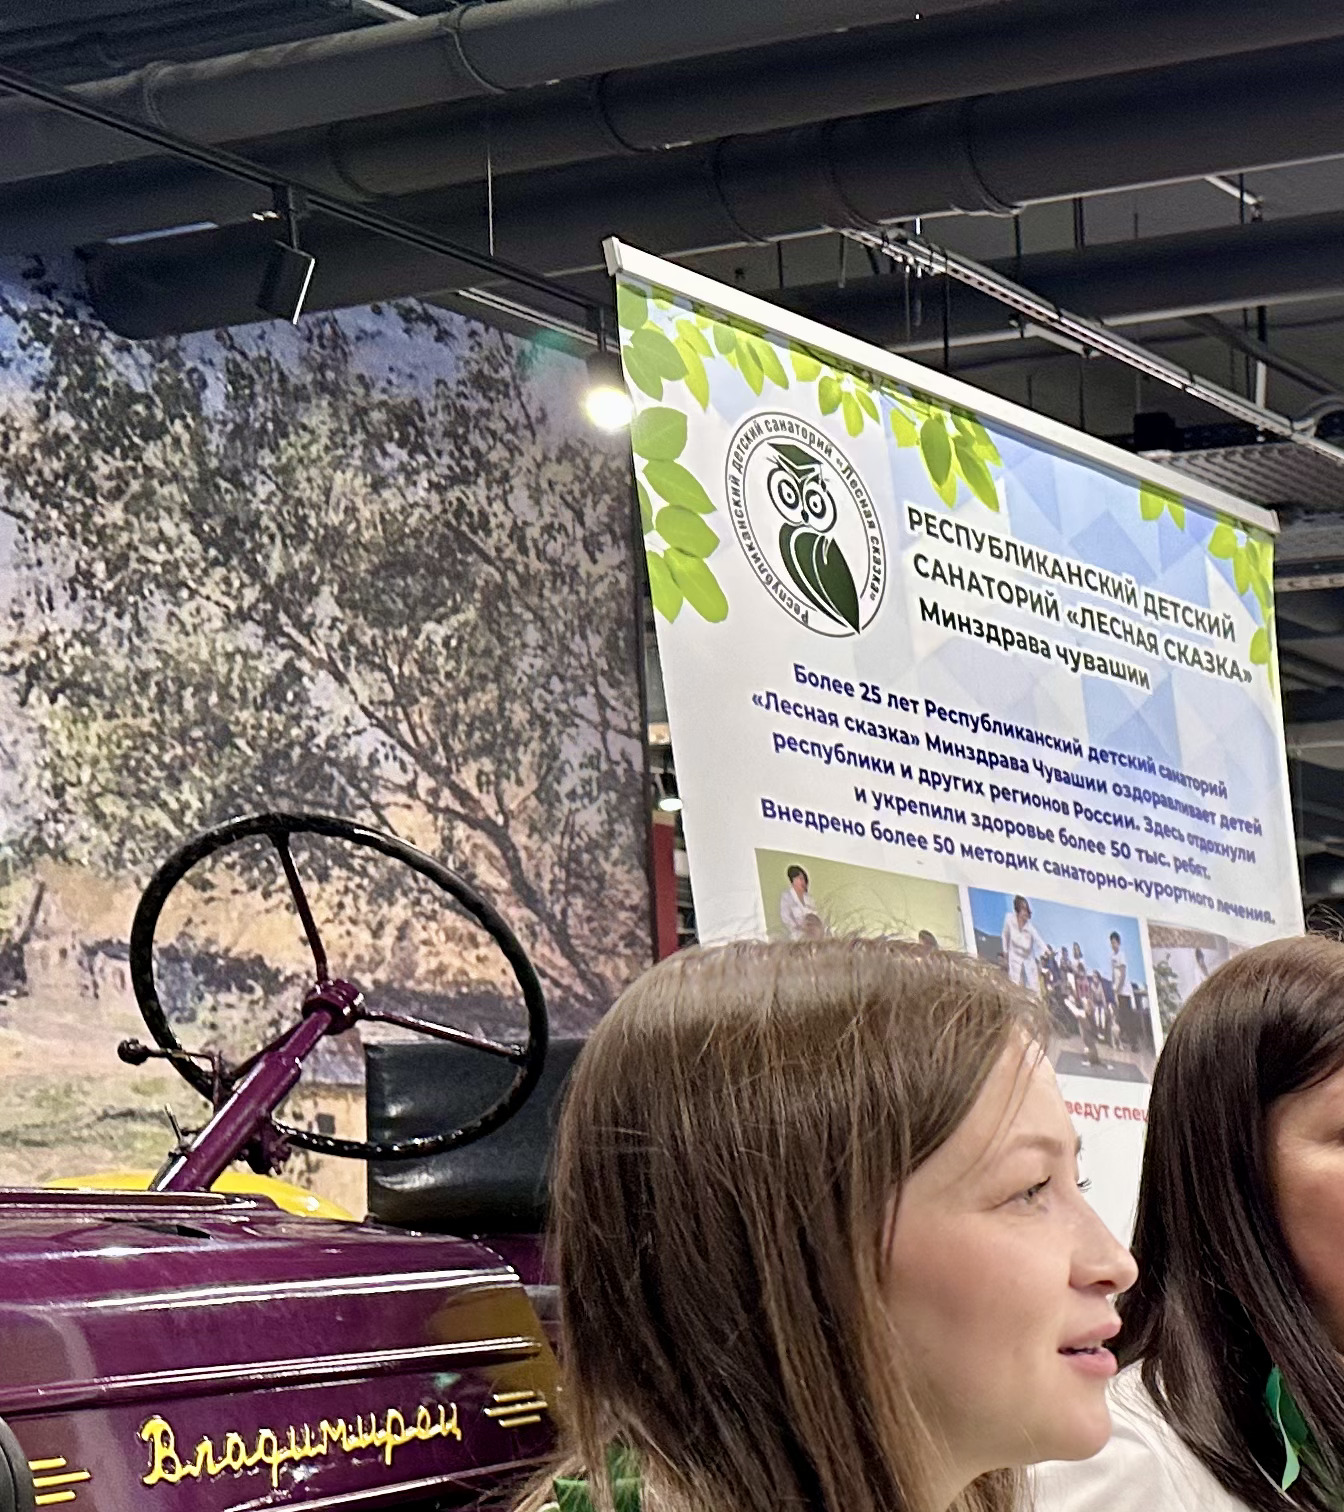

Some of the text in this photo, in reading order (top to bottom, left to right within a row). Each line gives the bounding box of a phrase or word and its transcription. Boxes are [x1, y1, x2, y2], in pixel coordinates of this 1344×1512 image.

[765, 418, 833, 458] санаторий
[907, 506, 1236, 643] РЕСПУБЛИКАНСКИЙ ДЕТСКИЙ
[913, 552, 1253, 684] САНАТОРИЙ «ЛЕСНАЯ СКАЗКА»
[918, 597, 1150, 690] Минздрава чувашии
[752, 690, 1262, 837] «Лесная сказка» Минздрава Чувашии оздоравливает детей
[793, 662, 1228, 800] Более 25 лет Республиканский детский санаторий
[760, 798, 866, 838] Внедрено
[870, 820, 929, 850] более
[932, 834, 955, 856] 50
[960, 842, 1039, 872] методик
[1043, 857, 1215, 912] санаторно-курортного
[772, 731, 1256, 864] республики и других регионов России. Здесь отдохнули
[854, 785, 1211, 880] и укрепили здоровье более 50 тыс. ребят.
